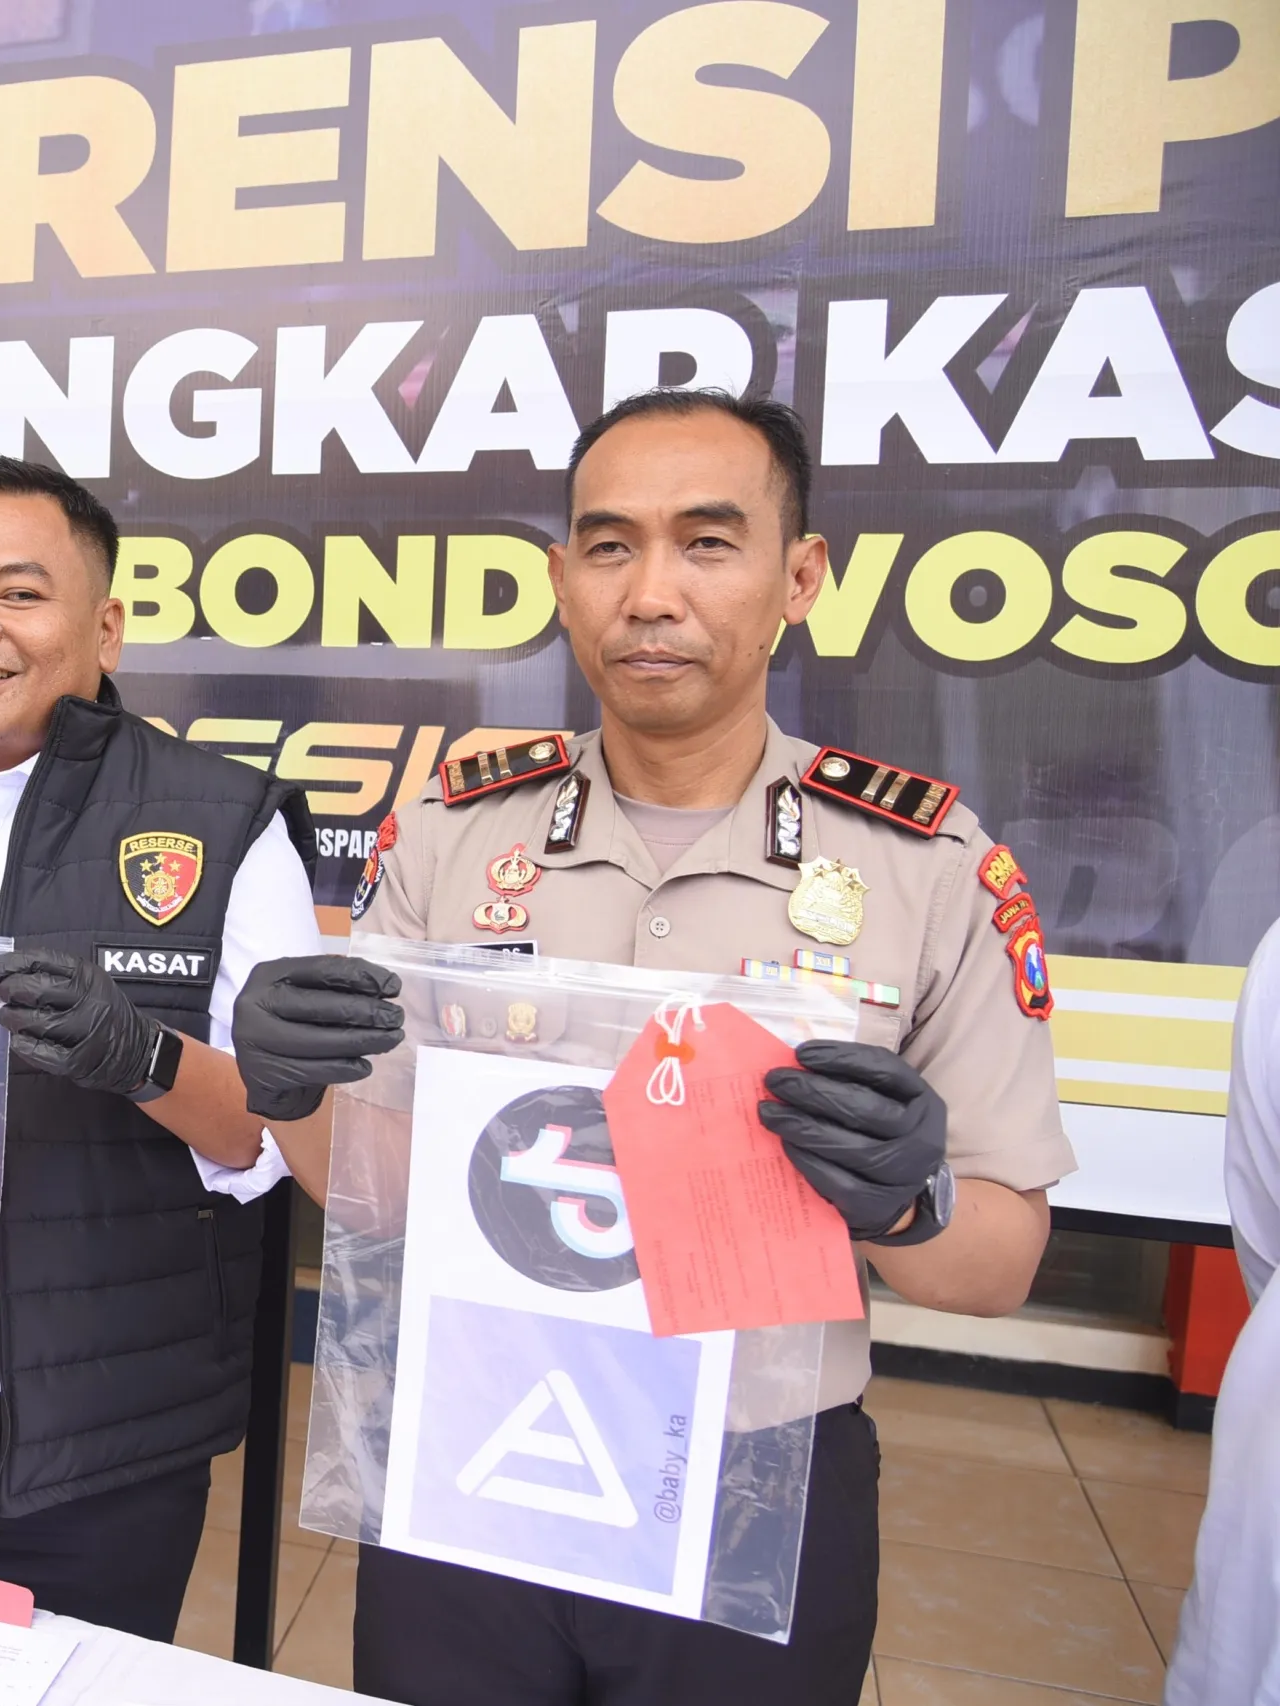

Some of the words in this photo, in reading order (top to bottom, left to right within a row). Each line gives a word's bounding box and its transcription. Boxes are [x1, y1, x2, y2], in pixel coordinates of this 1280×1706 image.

[122, 530, 1280, 666] BONDWOSO
[129, 837, 195, 853] RESERSE
[104, 950, 205, 977] KASAT
[653, 1414, 688, 1524] @baby_ka
